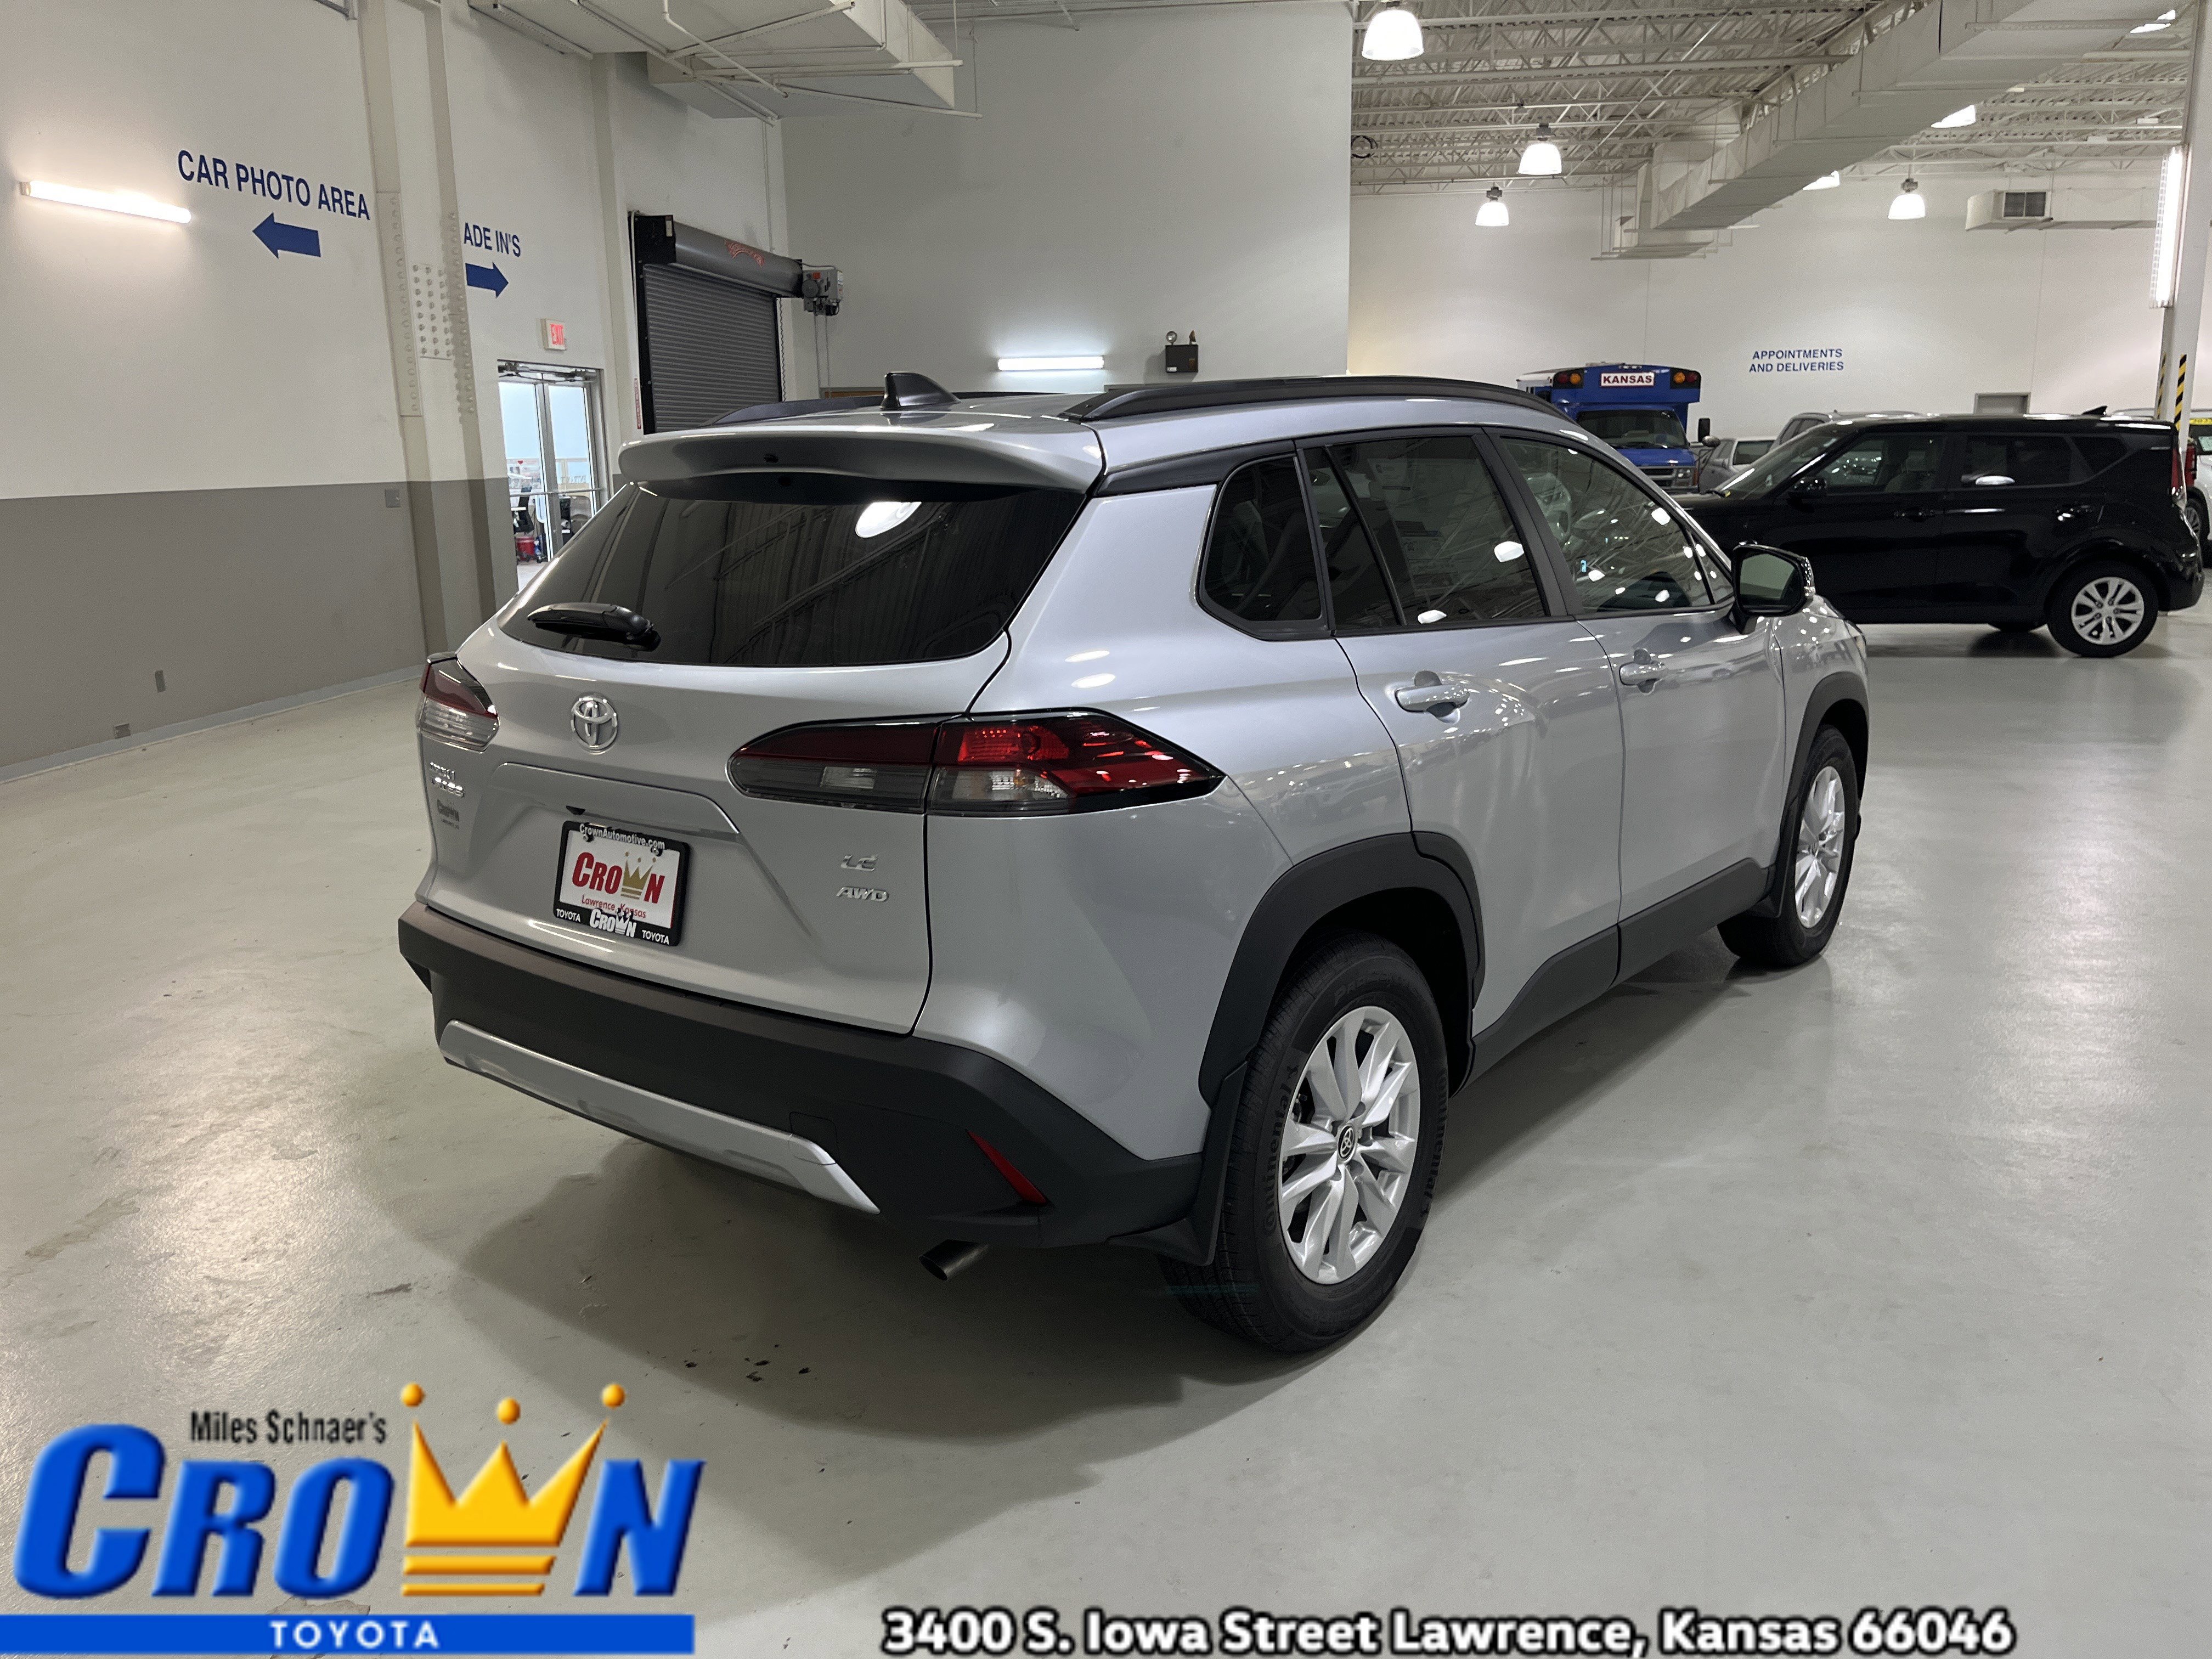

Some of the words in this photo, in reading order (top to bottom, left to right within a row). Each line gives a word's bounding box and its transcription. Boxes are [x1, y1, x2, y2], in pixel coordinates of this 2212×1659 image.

[178, 150, 229, 189] CAR
[235, 163, 311, 206] PHOTO
[318, 184, 370, 220] AREA
[464, 222, 493, 250] ADE
[495, 230, 521, 257] IN'S
[1752, 348, 1842, 359] APPOINTMENTS
[1749, 363, 1773, 372] AND
[1777, 362, 1844, 371] DELIVERIES
[1602, 375, 1652, 384] KANSAS
[579, 823, 665, 850] CrownAutomotive.com
[841, 855, 877, 871] LE
[572, 851, 665, 904] CROWN
[836, 887, 888, 902] AWD
[556, 909, 580, 923] TOYOTA
[642, 929, 669, 945] TOYOTA
